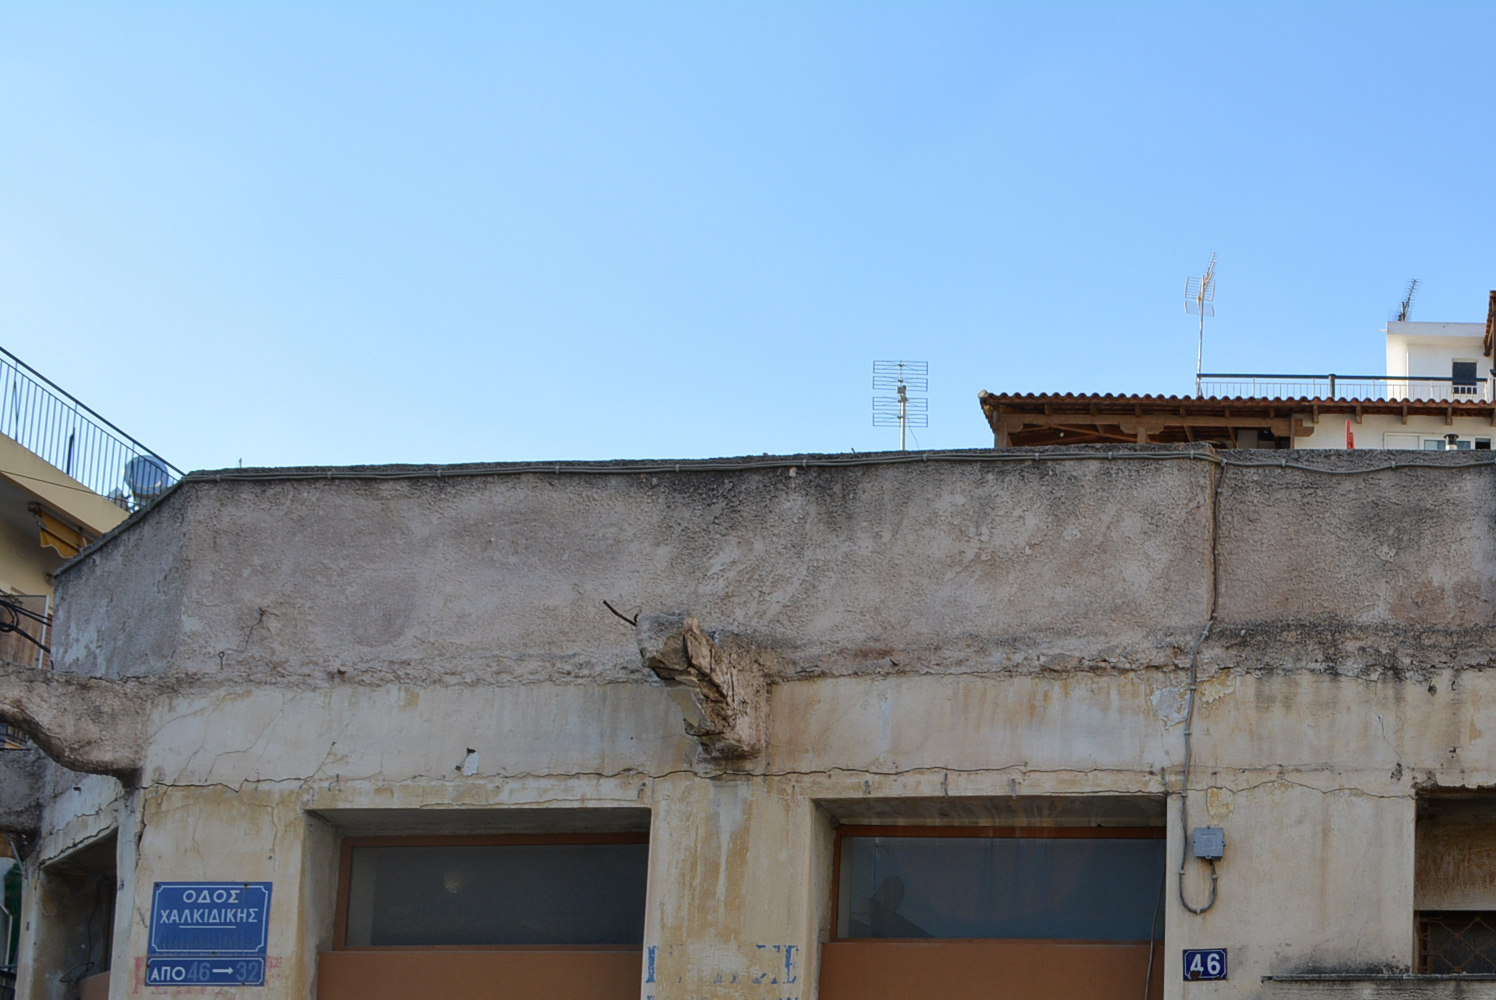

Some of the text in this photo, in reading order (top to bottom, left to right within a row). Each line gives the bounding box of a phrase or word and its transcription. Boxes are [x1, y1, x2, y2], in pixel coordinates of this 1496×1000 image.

[182, 889, 241, 904] ΟΔΟΣ
[159, 908, 259, 924] ΧΑΛΚΙΔΙΚΗΣ
[150, 966, 187, 981] ΑΠΟ
[187, 961, 211, 981] 46
[235, 961, 259, 981] 32
[1189, 952, 1221, 976] 46
